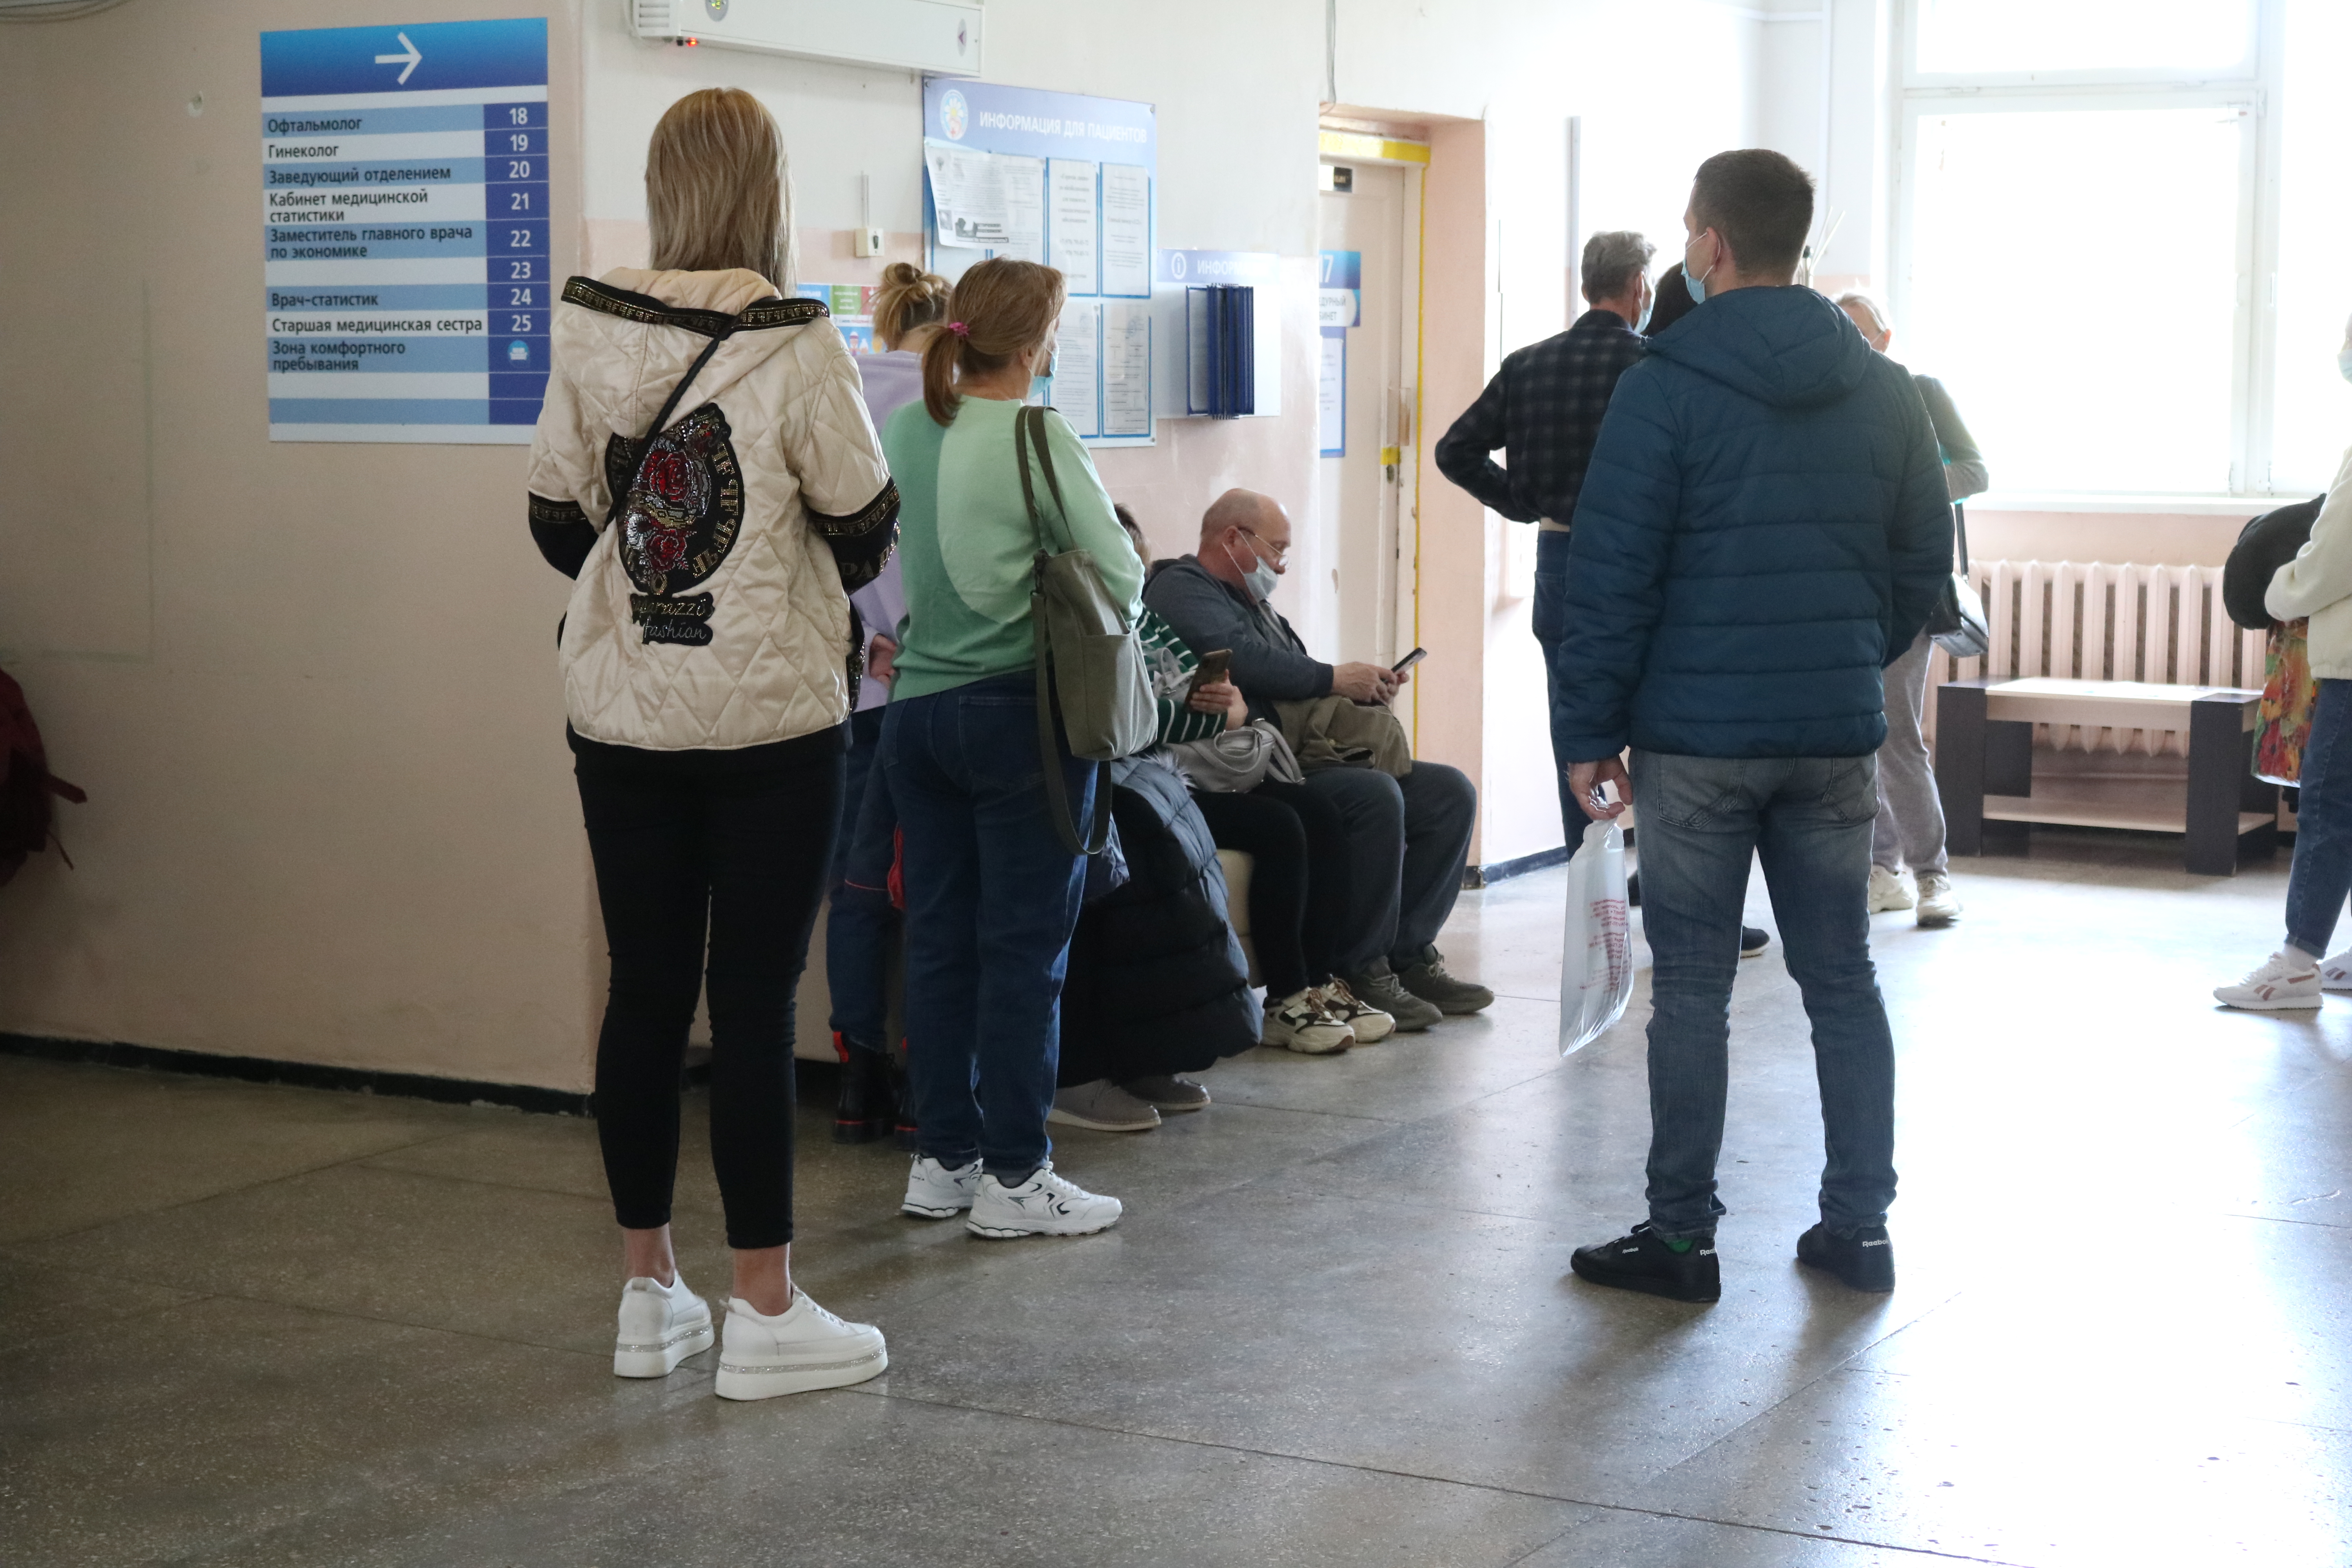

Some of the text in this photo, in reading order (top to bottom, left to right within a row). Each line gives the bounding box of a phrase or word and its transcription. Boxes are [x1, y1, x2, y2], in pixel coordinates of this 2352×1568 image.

[510, 108, 528, 125] 18
[268, 118, 362, 135] Офтальмолог
[979, 111, 1147, 143] ИНФОРМАЦИЯ ДЛЯ ПАЦИЕНТОВ
[268, 144, 339, 158] Гинеколог
[510, 134, 528, 151] 19
[269, 168, 451, 187] Заведующий отделением
[509, 161, 530, 178] 20
[270, 188, 428, 207] Кабинет медицинской
[511, 193, 530, 210] 21
[270, 211, 344, 223] статистики
[270, 227, 472, 243] Заместитель главного врача
[510, 230, 531, 248] 22
[271, 245, 367, 258] по экономике
[510, 261, 531, 279] 23
[272, 293, 378, 309] Врач-статистик
[510, 288, 532, 305] 24
[272, 318, 482, 334] Старшая медицинская сестра
[511, 314, 532, 332] 25
[273, 340, 405, 357] Зона комфортного
[273, 356, 359, 374] пребывания
[644, 615, 707, 639] fashion
[1699, 1248, 1716, 1256] Reeb
[1862, 1239, 1889, 1248] Reebok
